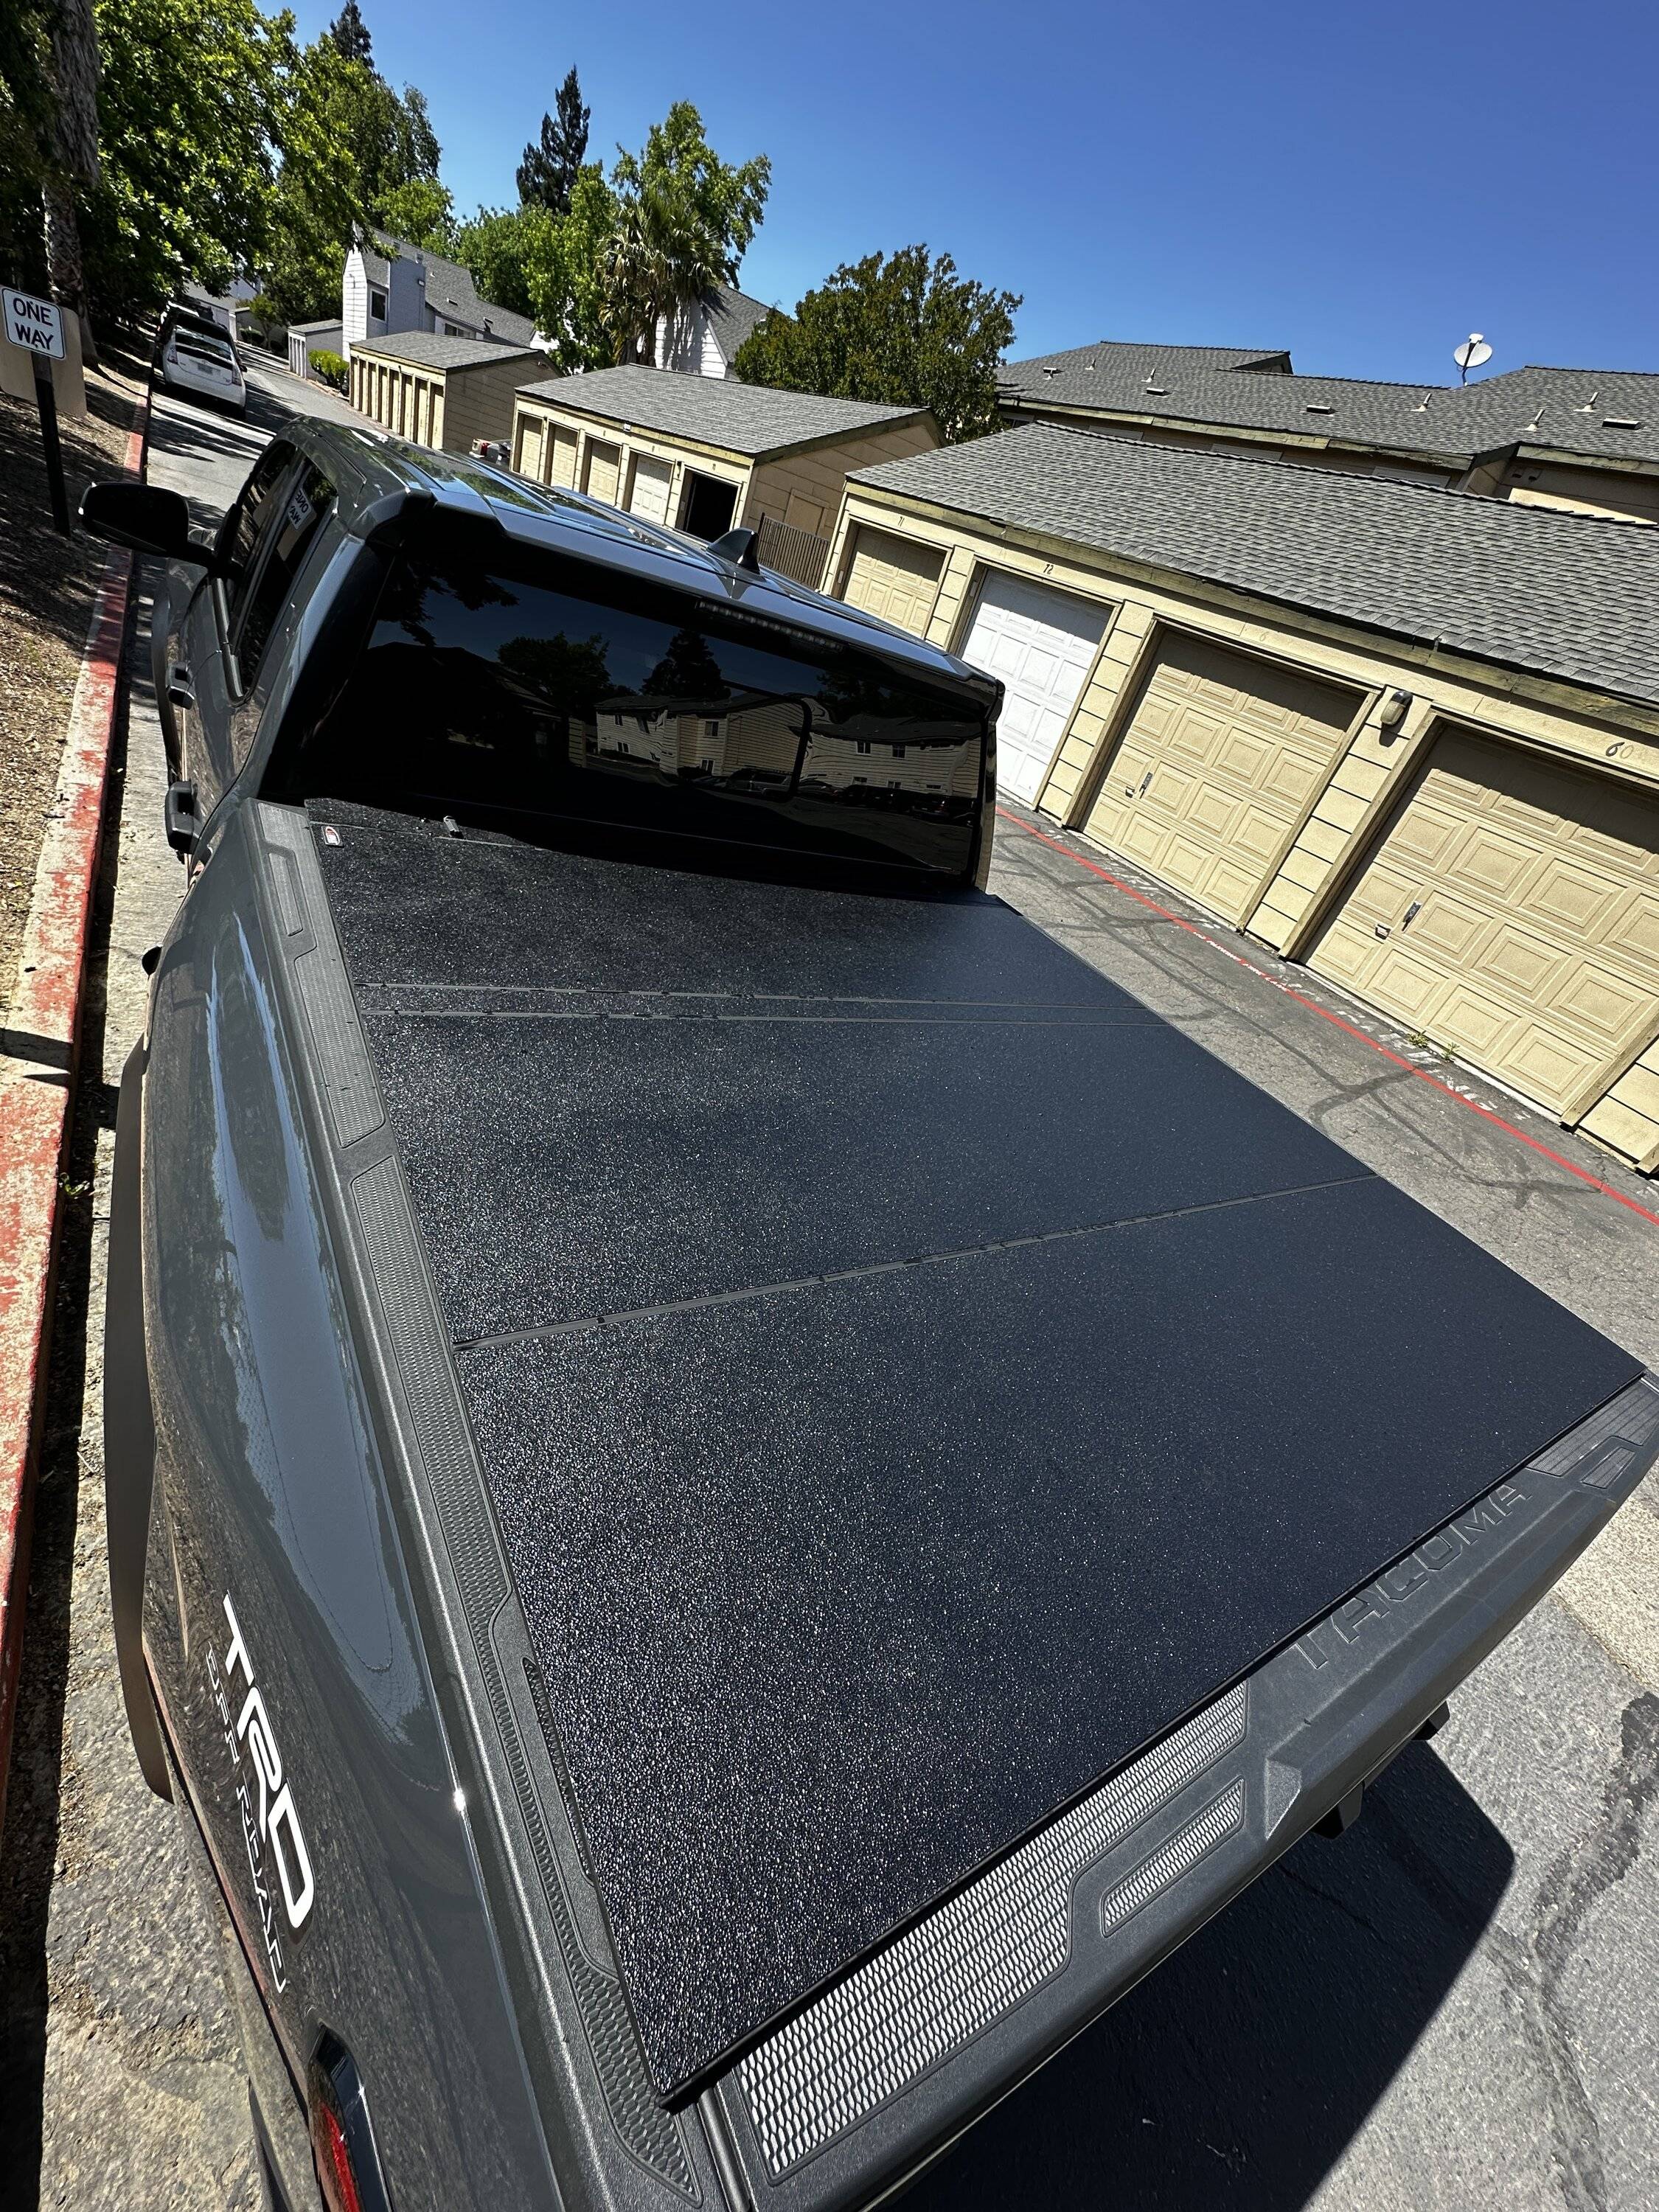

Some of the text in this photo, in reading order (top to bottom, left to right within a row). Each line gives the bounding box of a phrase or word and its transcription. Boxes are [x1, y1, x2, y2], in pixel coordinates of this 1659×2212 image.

[13, 298, 53, 327] ONE
[15, 322, 54, 350] WAY
[897, 516, 905, 526] 71
[1043, 564, 1054, 574] 72
[1273, 1484, 1534, 1670] TACOMA
[223, 1590, 313, 1928] TRD
[206, 1641, 286, 1994] OFF ROAD
